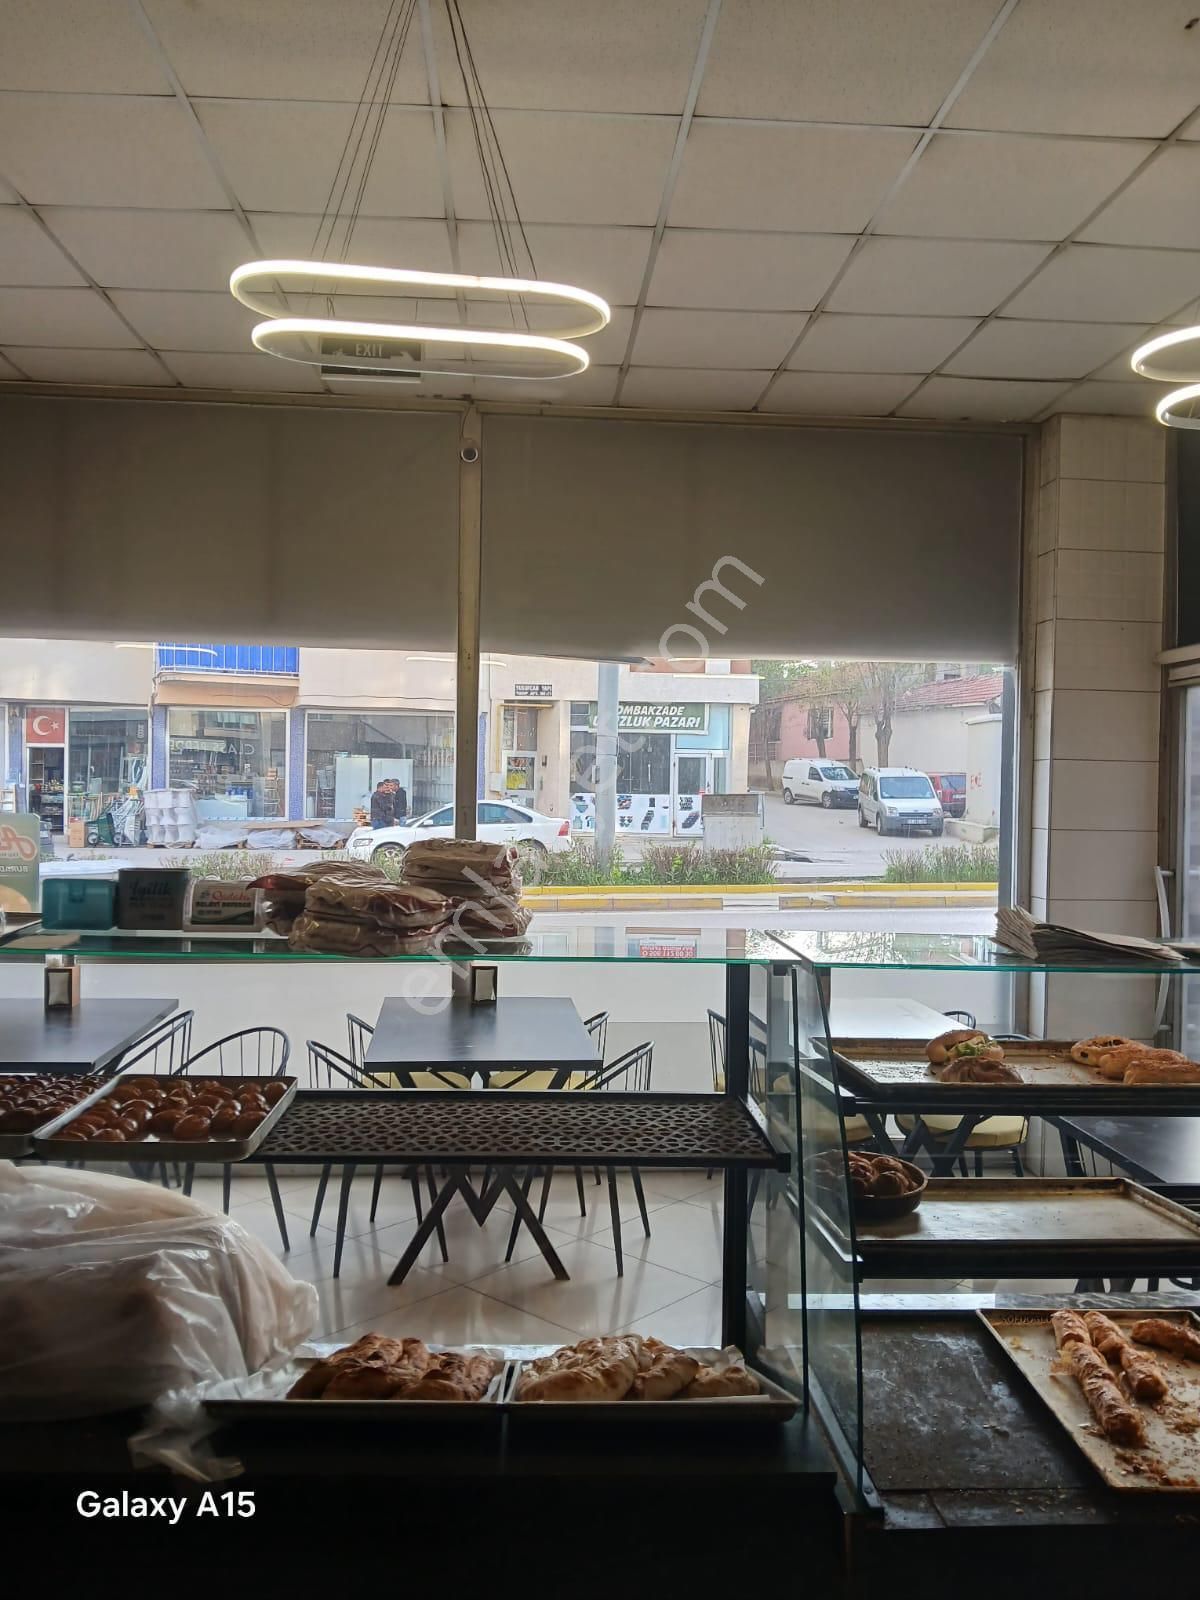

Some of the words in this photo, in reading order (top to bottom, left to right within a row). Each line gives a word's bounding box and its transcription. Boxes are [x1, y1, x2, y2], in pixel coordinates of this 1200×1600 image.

[355, 343, 383, 357] EXIT
[618, 705, 685, 716] OMBAKZADE
[653, 716, 701, 728] PAZARI
